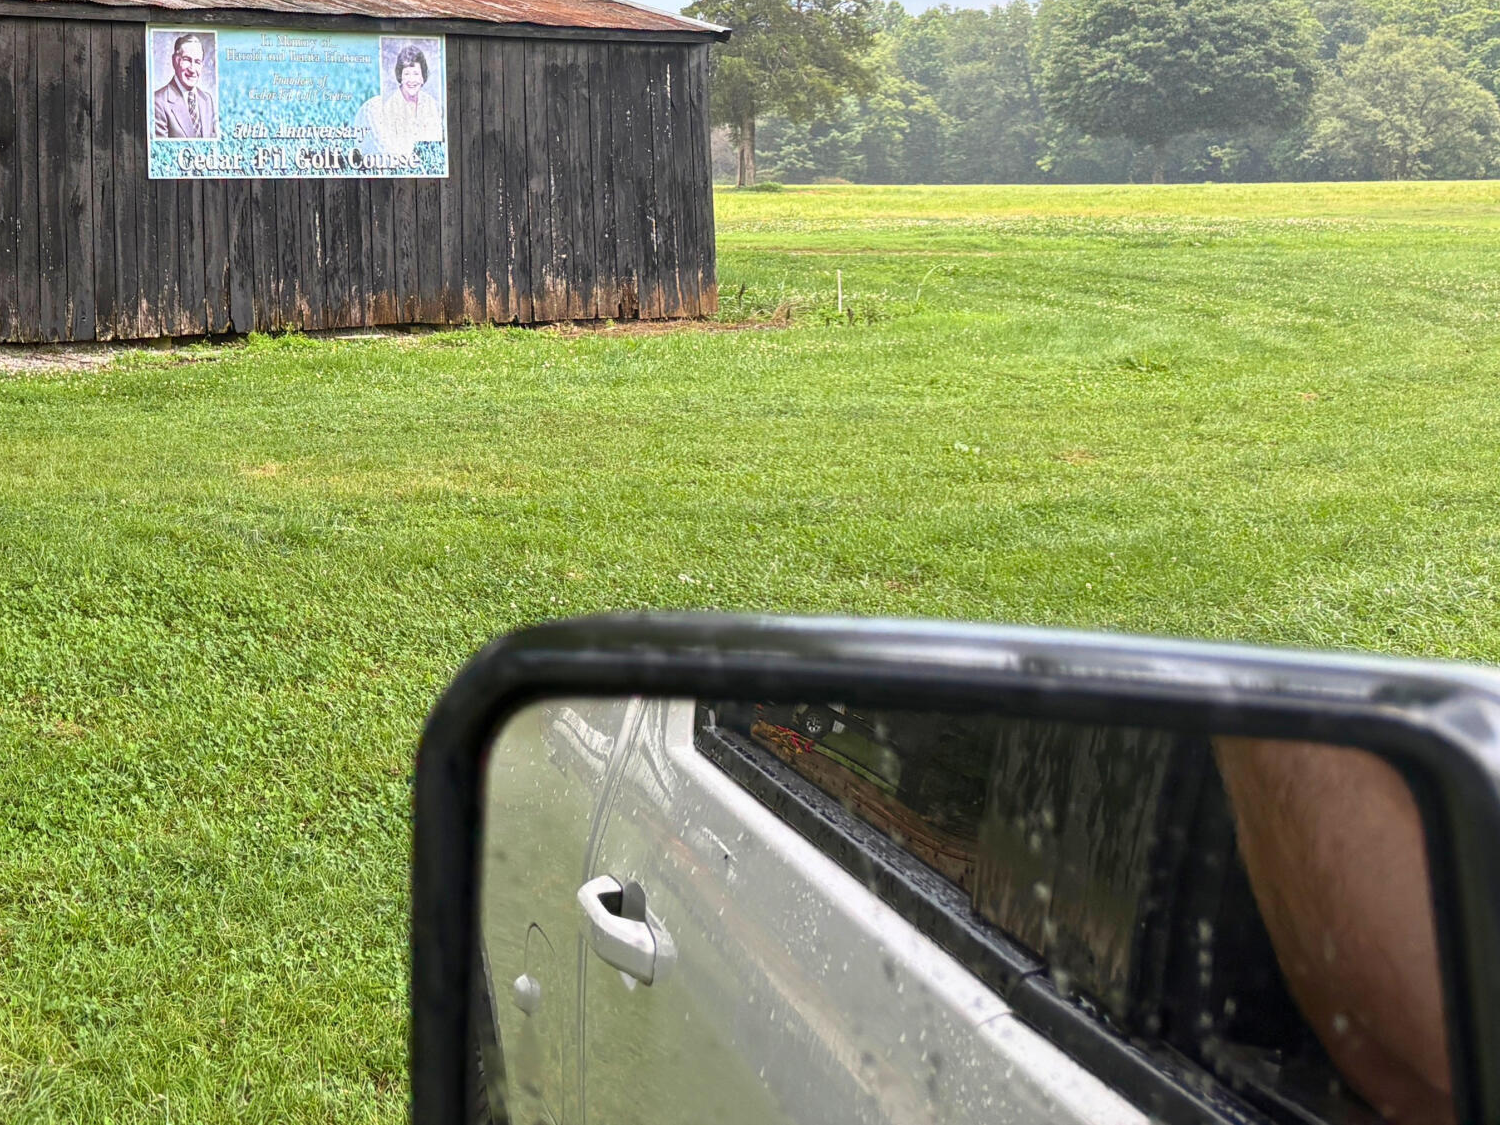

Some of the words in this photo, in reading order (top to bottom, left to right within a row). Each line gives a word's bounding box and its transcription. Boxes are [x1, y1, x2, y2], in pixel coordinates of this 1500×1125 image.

[260, 34, 274, 47] In
[225, 48, 262, 62] Harold
[267, 50, 286, 62] and
[317, 75, 329, 89] of
[232, 123, 269, 140] 50th
[271, 123, 372, 143] Anniversary
[177, 146, 244, 171] Cedar
[293, 147, 342, 170] Golf
[347, 146, 422, 169] Course
